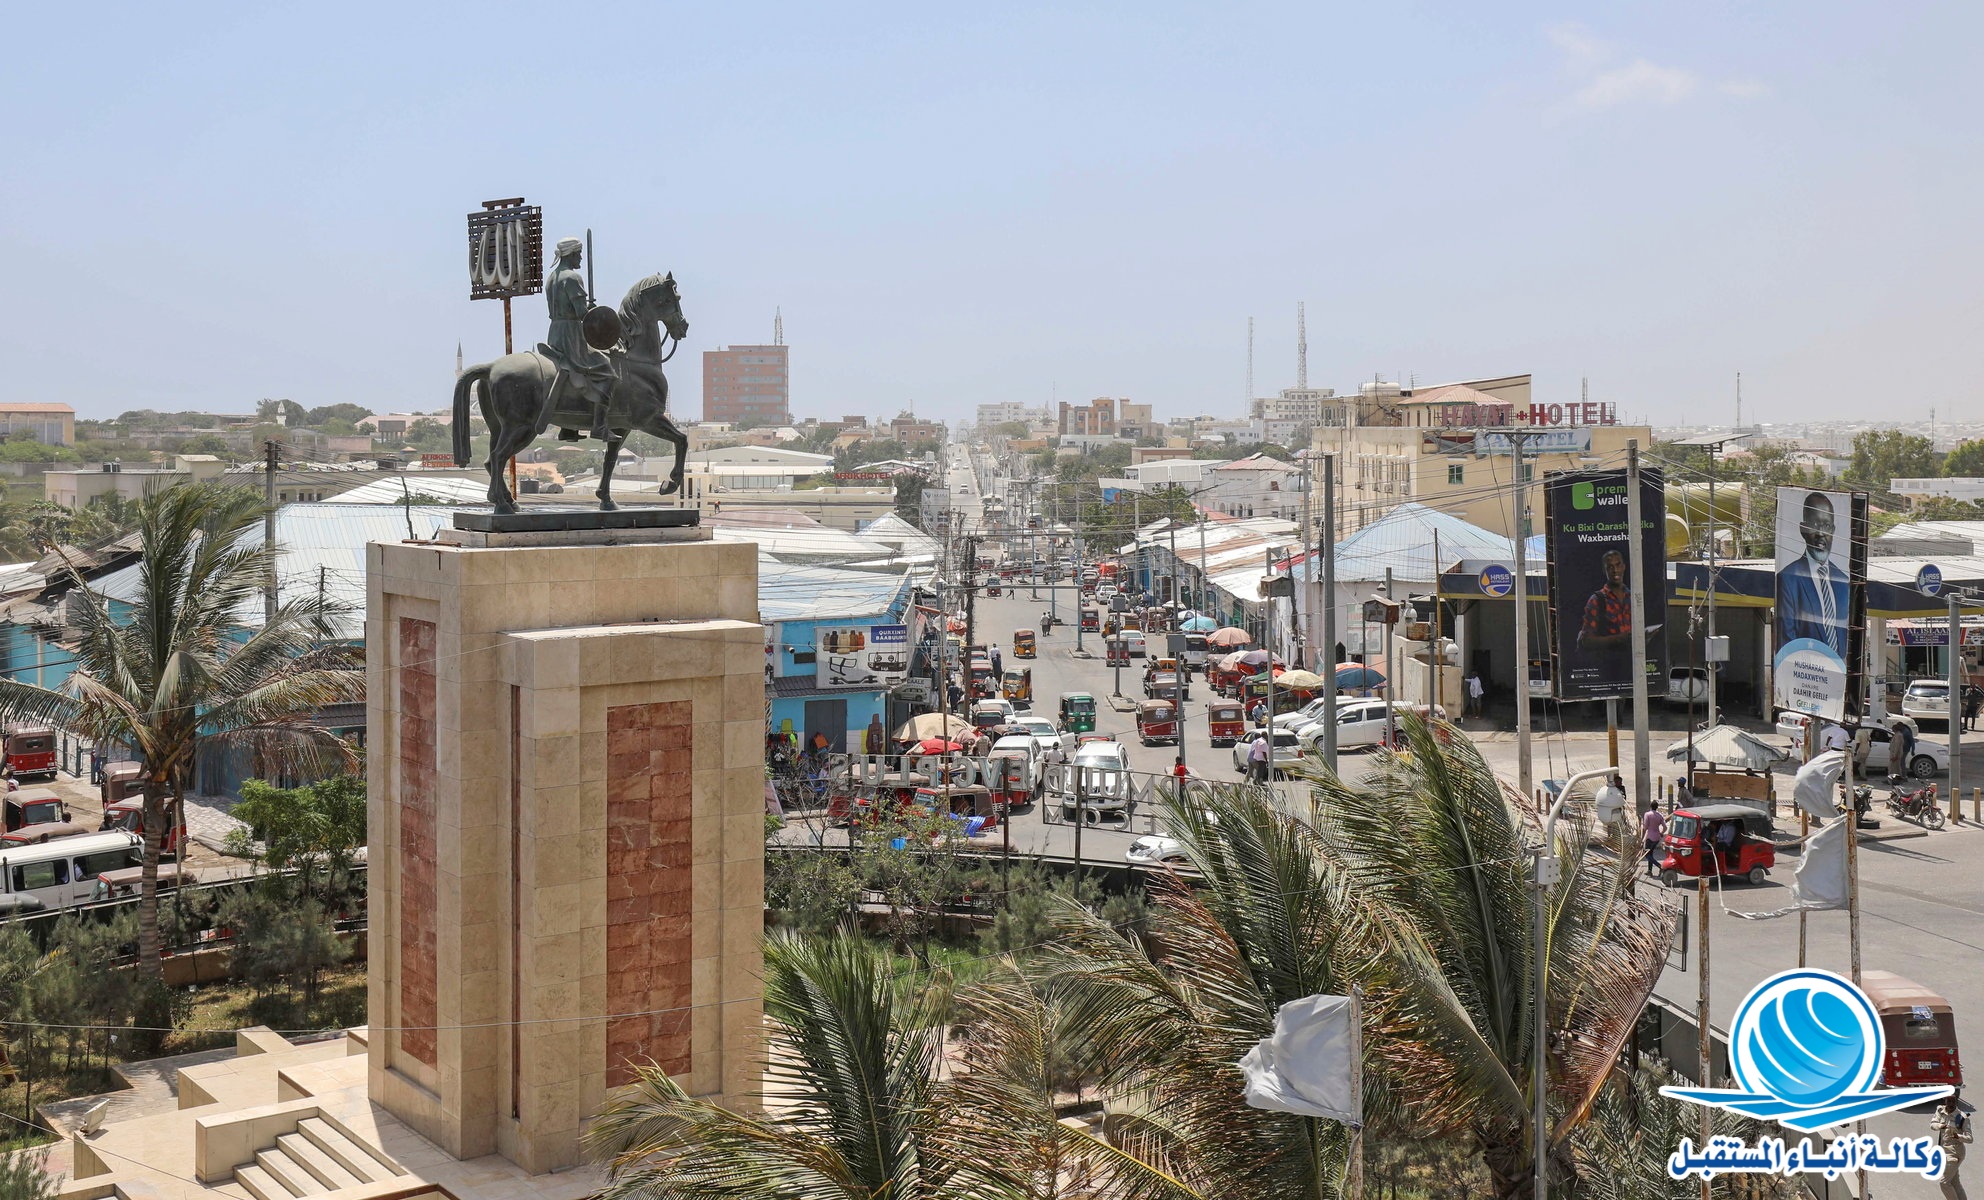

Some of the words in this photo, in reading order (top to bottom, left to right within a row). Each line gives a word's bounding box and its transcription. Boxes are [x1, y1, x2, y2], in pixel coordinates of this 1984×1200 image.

[1442, 403, 1514, 427] HAYAT
[1530, 402, 1617, 426] HOTEL
[1597, 485, 1627, 496] prem
[1597, 495, 1628, 506] walle
[1563, 524, 1575, 532] Ku
[1578, 523, 1594, 532] Bixi
[1793, 671, 1828, 684] MADAXWEYNE
[1793, 688, 1811, 697] DAAHIR
[1812, 691, 1828, 701] GEELLE
